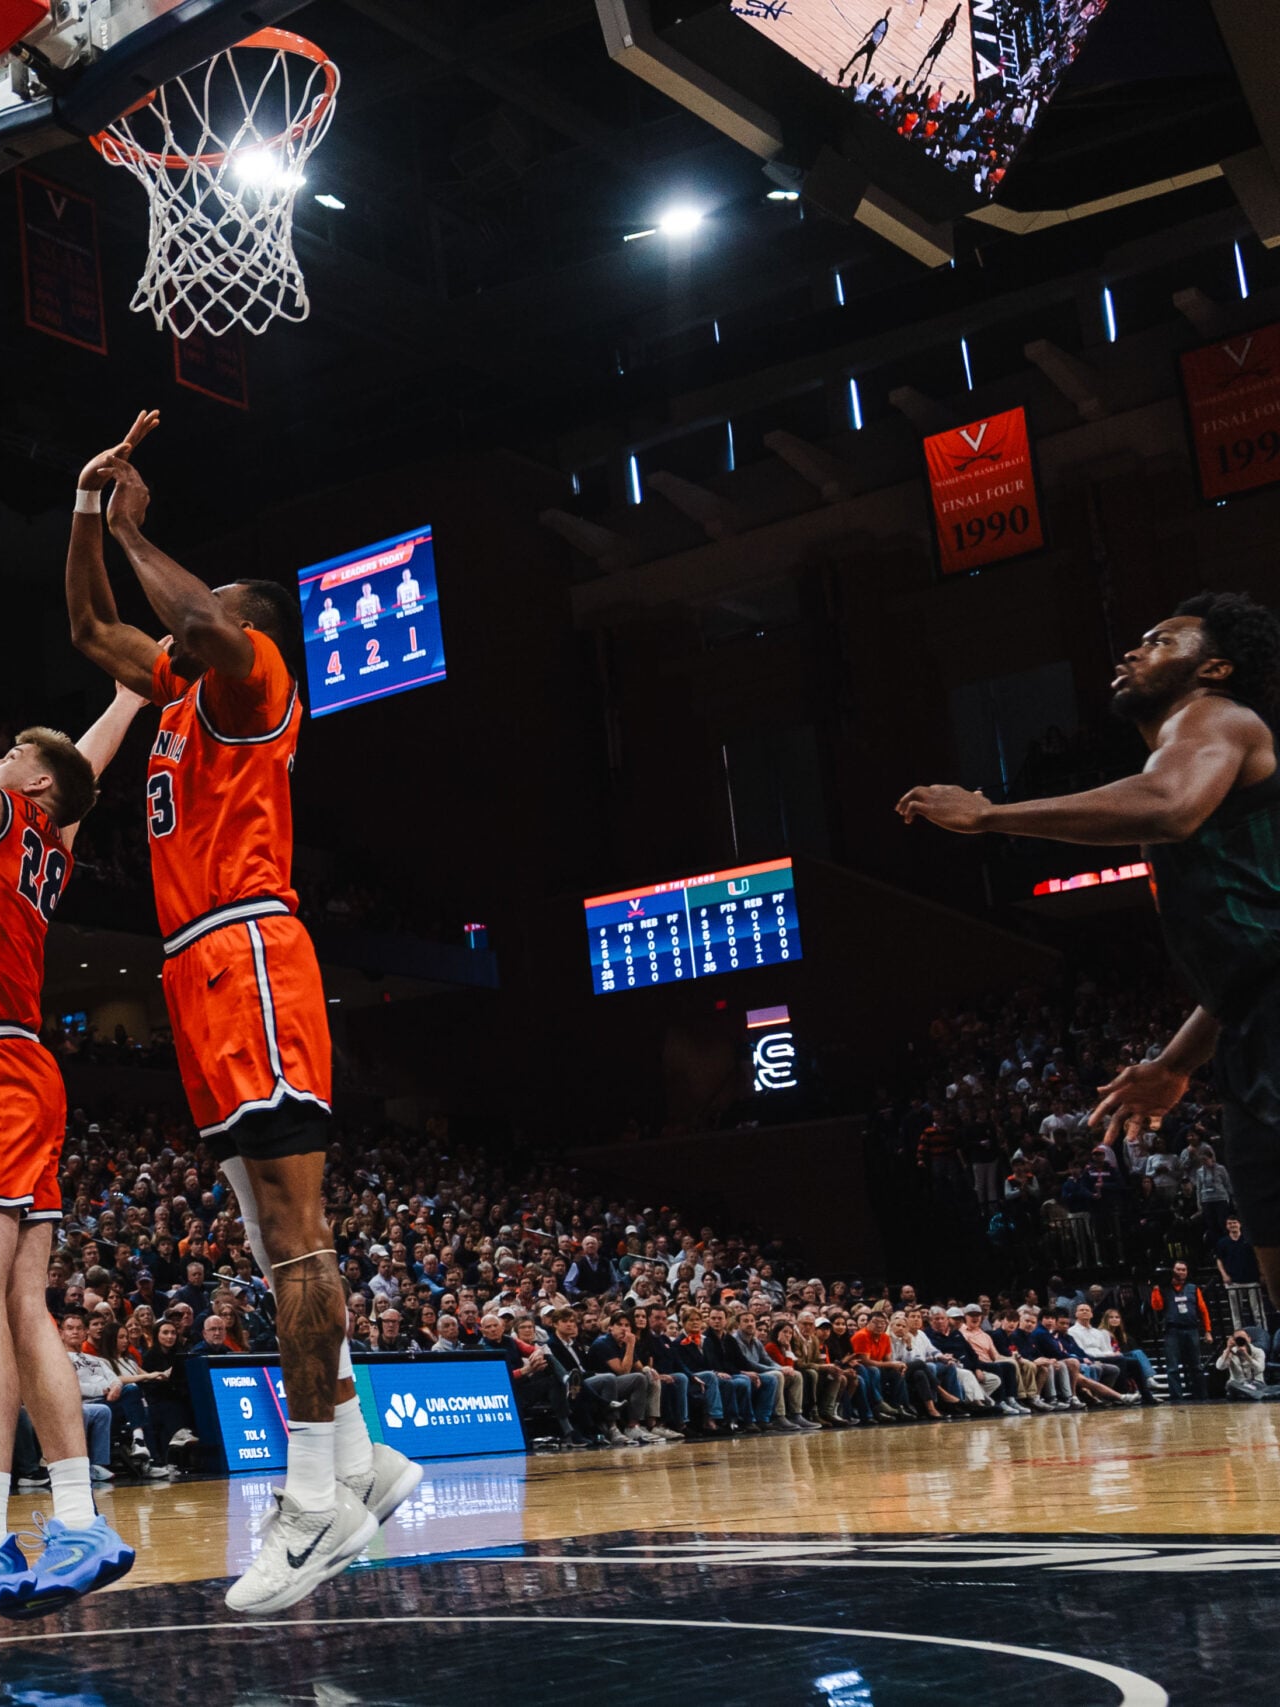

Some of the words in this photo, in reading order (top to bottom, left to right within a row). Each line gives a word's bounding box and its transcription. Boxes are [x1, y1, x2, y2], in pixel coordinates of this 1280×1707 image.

[1222, 336, 1254, 367] V
[958, 422, 988, 452] V
[942, 492, 984, 513] FINAL
[986, 479, 1025, 500] FOUR
[952, 505, 1030, 552] 1990
[341, 561, 377, 580] LEADERS
[378, 552, 405, 567] TODAY
[327, 650, 342, 675] 4
[366, 638, 381, 666] 2
[17, 826, 68, 924] 28
[727, 878, 750, 895] U
[720, 902, 737, 914] PTS
[744, 897, 763, 909] REB
[772, 893, 785, 904] PF
[618, 922, 634, 933] PTS
[640, 918, 658, 929] REB
[666, 913, 679, 924] PF
[701, 919, 709, 930] 3
[726, 915, 734, 925] 5
[751, 910, 758, 920] 0
[776, 905, 784, 915] 0
[702, 930, 710, 940] 5
[727, 926, 735, 936] 0
[752, 921, 760, 931] 1
[777, 916, 785, 926] 0
[601, 939, 608, 949] 2
[623, 934, 631, 945] 0
[647, 930, 654, 940] 0
[670, 926, 678, 935] 0
[602, 949, 609, 959] 5
[625, 945, 632, 954] 4
[648, 940, 655, 950] 0
[671, 936, 679, 946] 0
[704, 941, 711, 951] 7
[728, 936, 736, 946] 0
[753, 932, 761, 942] 0
[779, 927, 786, 937] 0
[730, 947, 737, 957] 0
[755, 943, 763, 953] 1
[780, 938, 788, 948] 0
[625, 955, 633, 965] 0
[649, 951, 657, 961] 0
[673, 947, 680, 956] 0
[627, 966, 634, 976] 2
[650, 962, 658, 971] 0
[674, 957, 681, 967] 0
[703, 962, 717, 973] 35
[731, 958, 739, 968] 0
[756, 954, 764, 964] 1
[781, 949, 789, 959] 0
[602, 980, 615, 990] 33
[628, 976, 635, 986] 0
[651, 972, 659, 982] 0
[675, 968, 683, 977] 0
[222, 1376, 258, 1388] VIRGINIA
[239, 1397, 253, 1419] 9
[425, 1397, 449, 1412] UVA
[448, 1394, 509, 1411] COMMUNITY
[430, 1414, 471, 1426] CREDIT
[477, 1412, 512, 1423] UNION
[244, 1430, 260, 1441] TOL
[259, 1428, 266, 1440] 4
[239, 1448, 263, 1459] FOULS
[263, 1446, 271, 1458] 1
